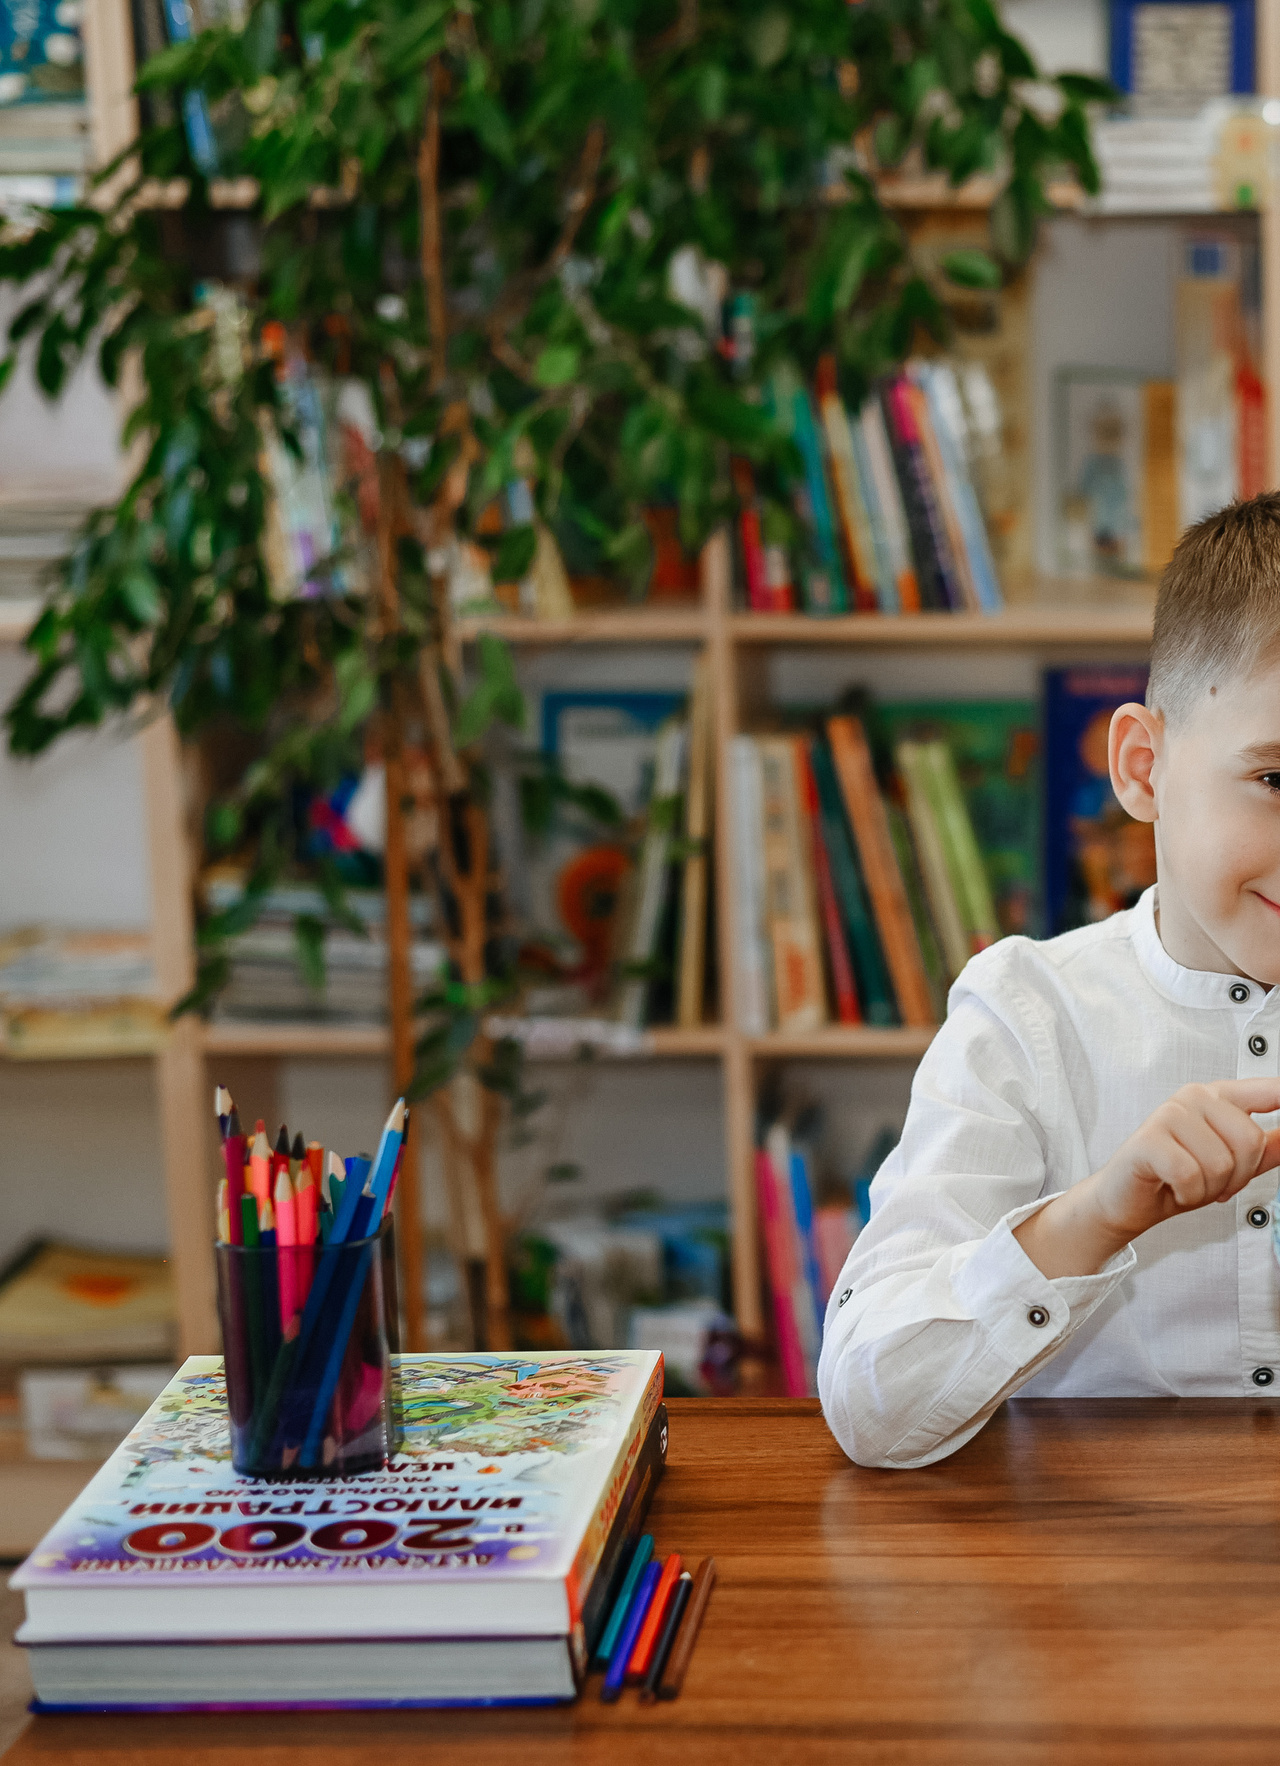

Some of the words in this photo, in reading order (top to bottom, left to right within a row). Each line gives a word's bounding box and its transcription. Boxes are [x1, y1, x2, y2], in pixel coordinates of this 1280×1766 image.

[385, 1462, 455, 1473] ЦЕЛ
[205, 1488, 315, 1497] МОЖНО
[325, 1486, 459, 1496] КОТОРЫЕ
[124, 1518, 477, 1556] 2000
